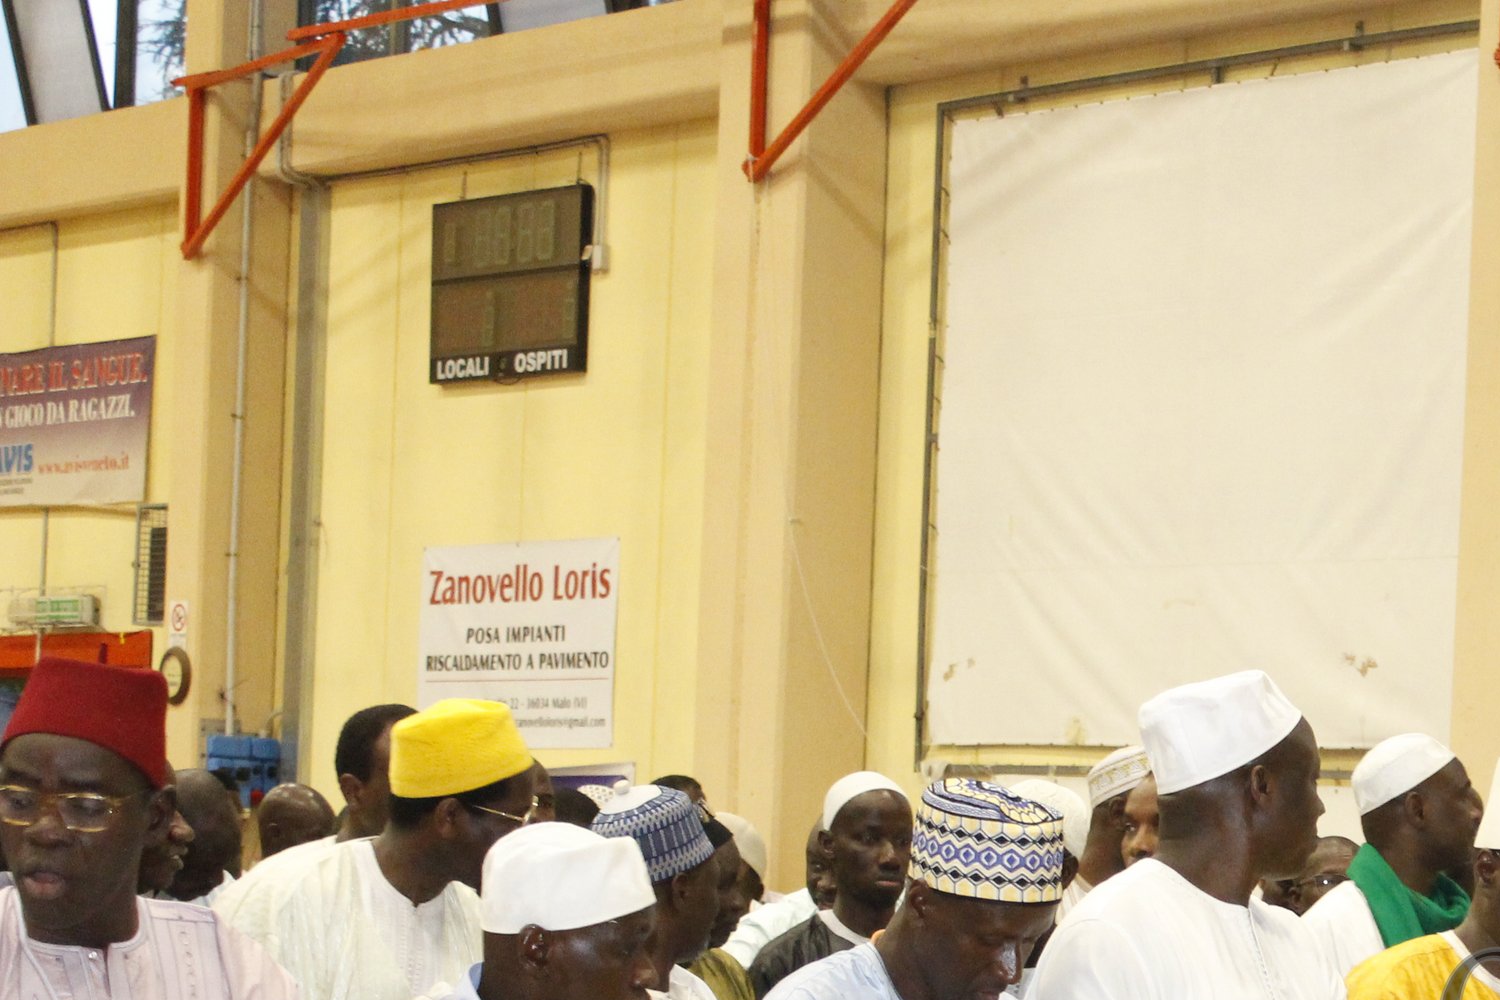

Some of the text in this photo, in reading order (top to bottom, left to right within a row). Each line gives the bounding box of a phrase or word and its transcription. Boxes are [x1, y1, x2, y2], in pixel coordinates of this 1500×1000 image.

[48, 360, 68, 392] IL
[71, 352, 147, 390] SANGUE.
[436, 349, 568, 380] LOCALI OSPITI
[5, 403, 45, 429] GIOCO
[47, 401, 65, 425] DA
[68, 394, 136, 423] RAGAZZI.
[429, 562, 611, 605] Zanovello Loris
[466, 625, 566, 644] POSA IMPIANTI
[426, 651, 609, 672] RISCALDAMENTO A PAVIMENTO
